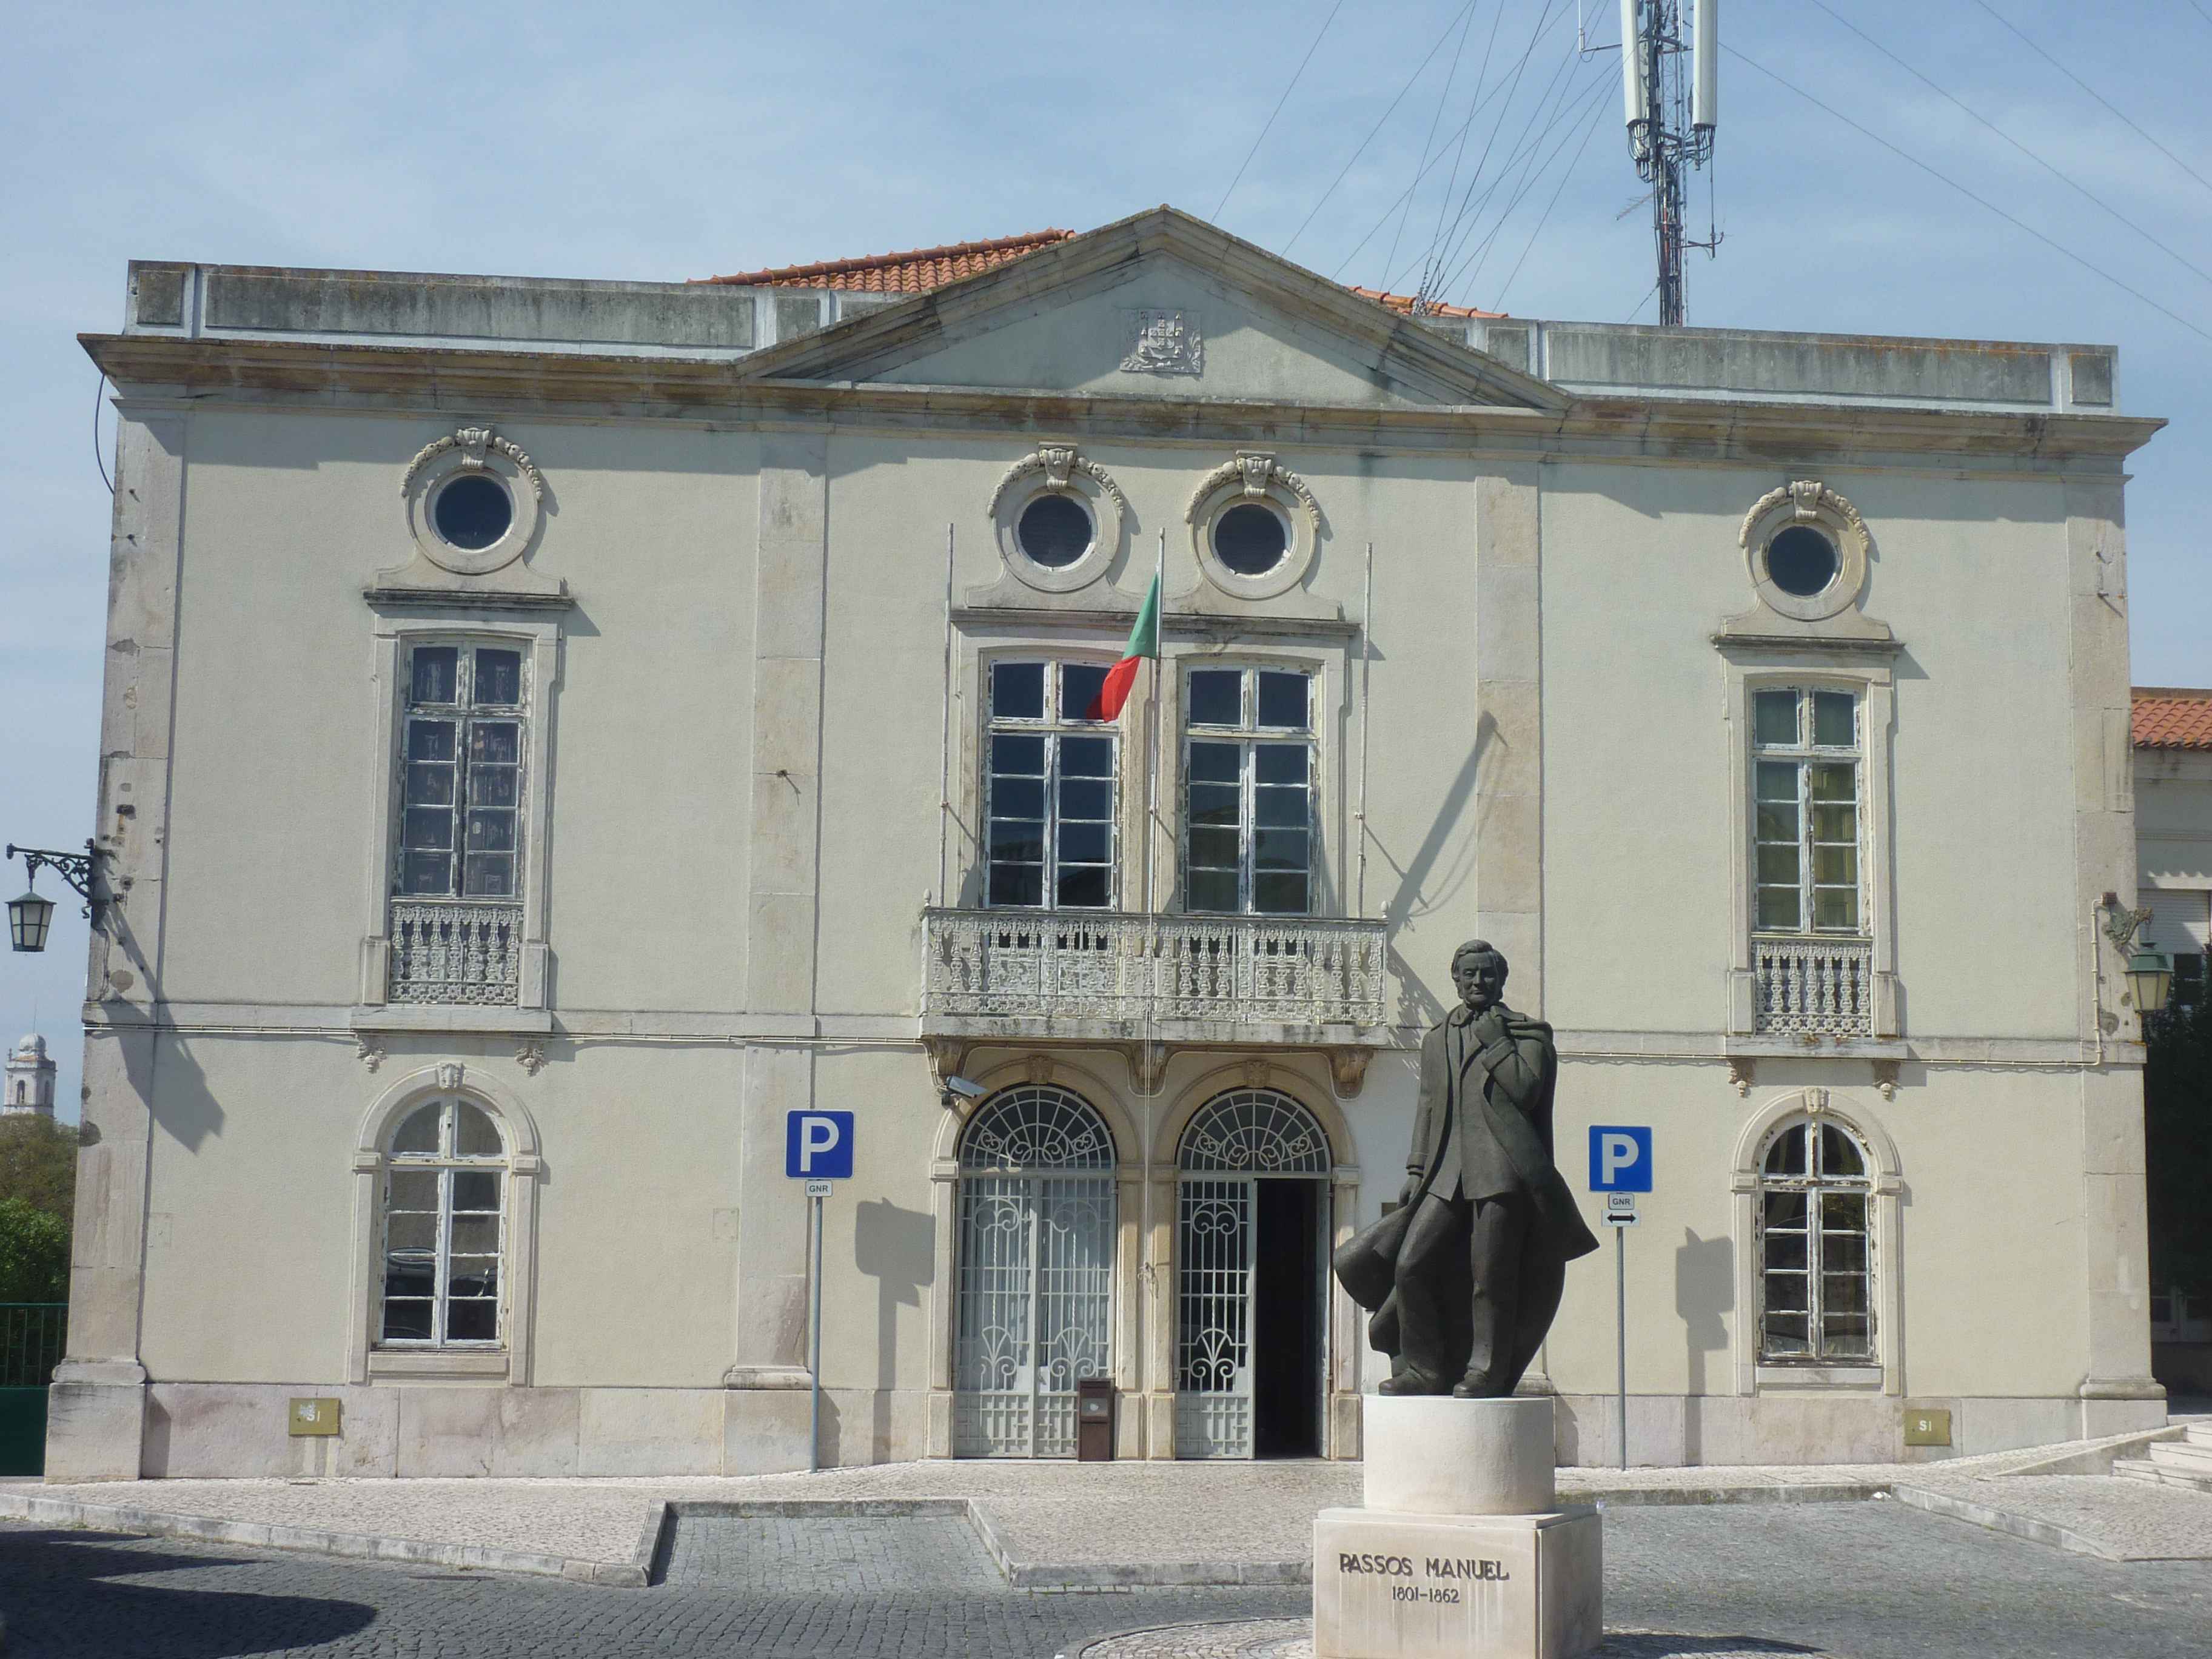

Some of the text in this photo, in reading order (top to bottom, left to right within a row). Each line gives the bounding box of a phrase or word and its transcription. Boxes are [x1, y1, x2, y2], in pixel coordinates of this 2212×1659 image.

[800, 1117, 839, 1171] P
[1602, 1133, 1639, 1184] P
[1339, 1553, 1509, 1581] PASSOS MANUEL
[1392, 1586, 1460, 1603] 1801-1862
